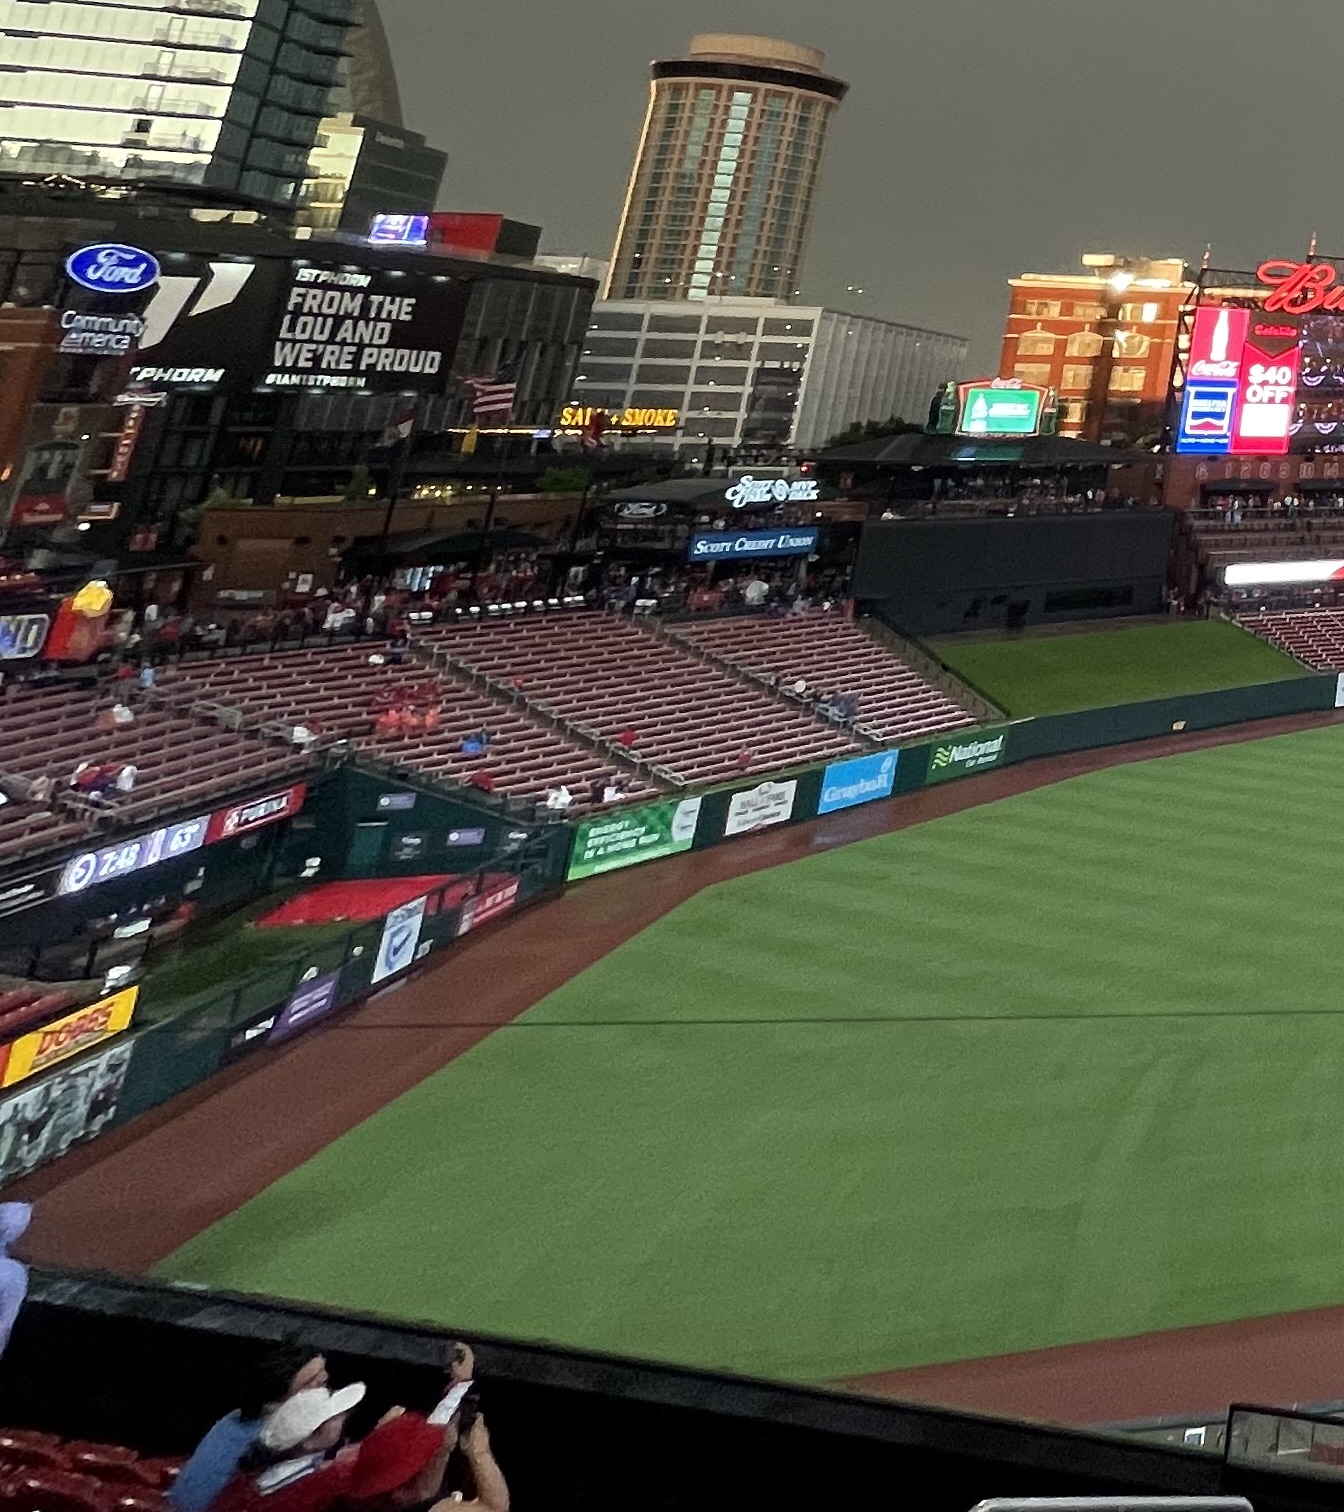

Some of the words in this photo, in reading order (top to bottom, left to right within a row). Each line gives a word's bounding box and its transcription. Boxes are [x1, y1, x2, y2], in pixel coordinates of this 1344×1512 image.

[86, 249, 148, 284] Ford
[287, 287, 364, 316] FROM
[368, 295, 417, 321] THE
[279, 314, 334, 341] LOU
[335, 319, 392, 345] AND
[274, 341, 358, 370] WE'RE
[359, 347, 443, 374] PROUD
[1248, 363, 1292, 384] $40
[1245, 385, 1291, 403] OFF
[621, 408, 678, 426] SMOKE
[1259, 462, 1271, 479] 6
[949, 735, 1003, 763] National
